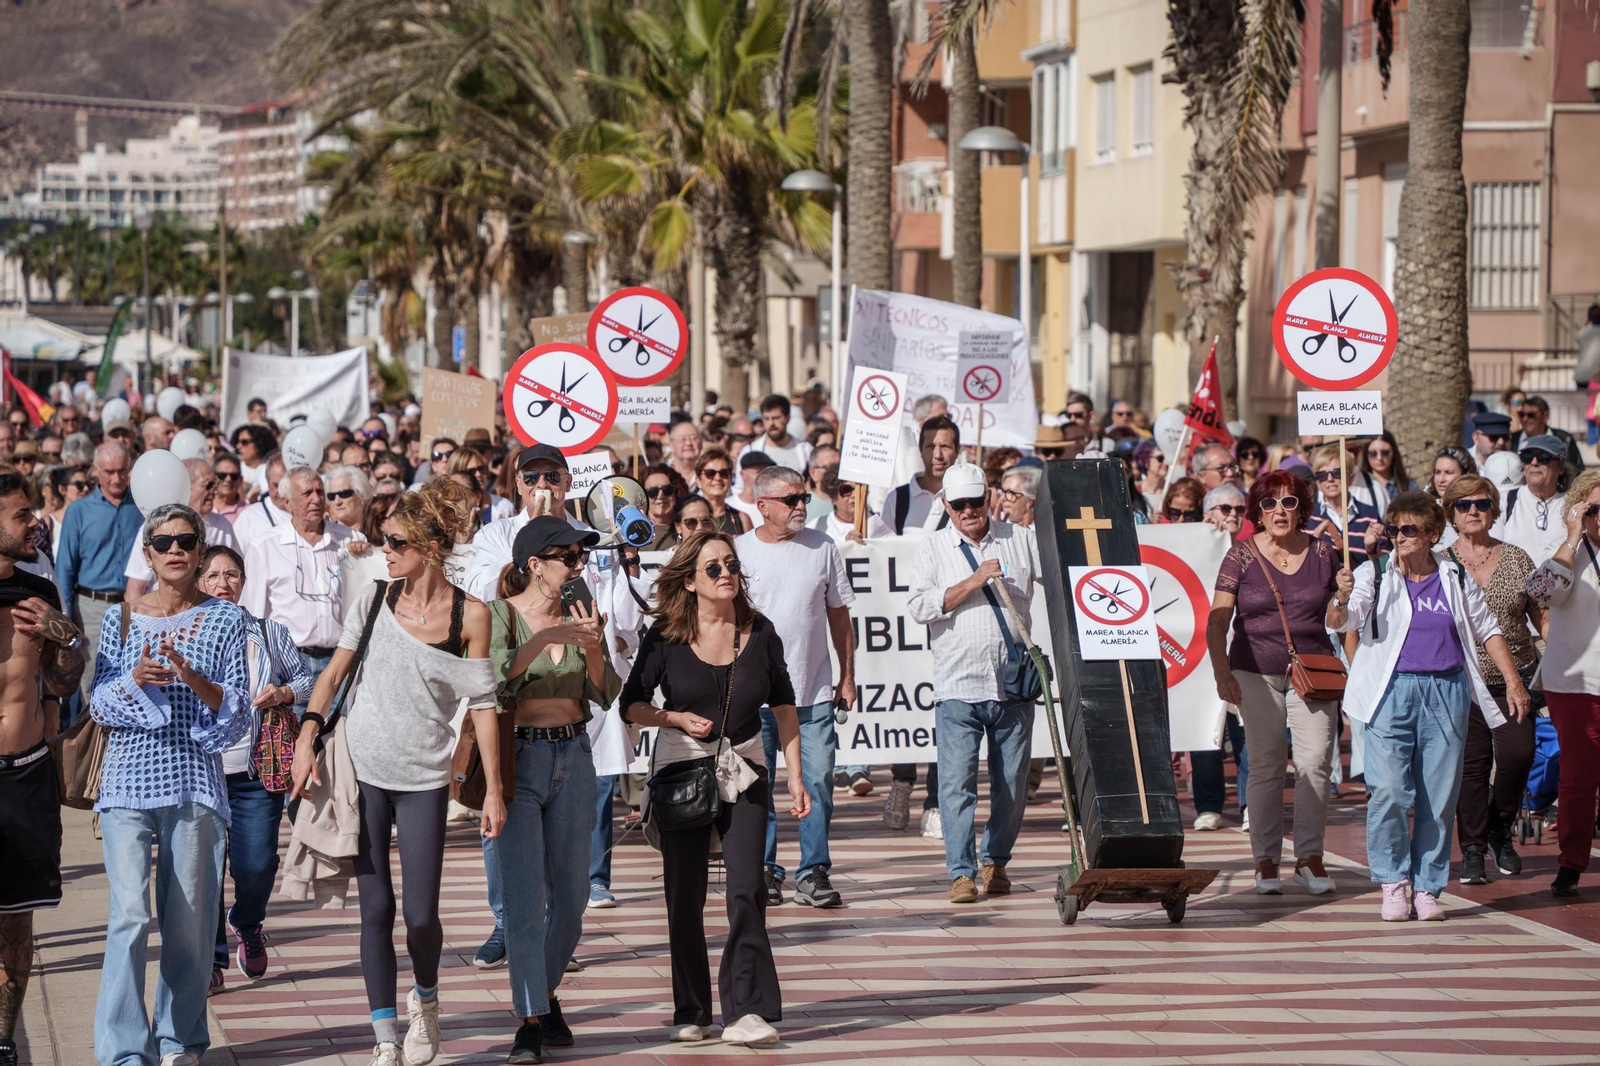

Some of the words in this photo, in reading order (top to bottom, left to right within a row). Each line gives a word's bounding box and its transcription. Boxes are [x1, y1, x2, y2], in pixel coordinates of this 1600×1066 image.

[1286, 316, 1308, 326] MAREA
[1322, 324, 1348, 335] BLANCA
[1358, 332, 1387, 343] ALMERÍA
[601, 317, 619, 329] MAREA
[628, 330, 648, 343] BLANCA
[654, 342, 677, 356] ALMERÍA
[518, 377, 539, 390] MAREA
[550, 392, 573, 406] BLANCA
[579, 406, 606, 423] ALMERÍA
[618, 396, 633, 404] REA
[636, 396, 668, 404] BLANCA
[618, 407, 655, 416] ALMERÍA
[1300, 402, 1335, 411] MAREA
[1339, 402, 1378, 411] BLANCA
[1318, 415, 1363, 426] ALMERÍA
[866, 431, 890, 440] sanidad
[572, 463, 608, 475] BLANCA
[571, 477, 596, 490] ERÍA
[846, 557, 872, 593] E
[888, 556, 910, 592] L
[1100, 637, 1138, 645] ALMERÍA
[1158, 635, 1187, 667] MERÍA
[857, 681, 935, 713] IZAC
